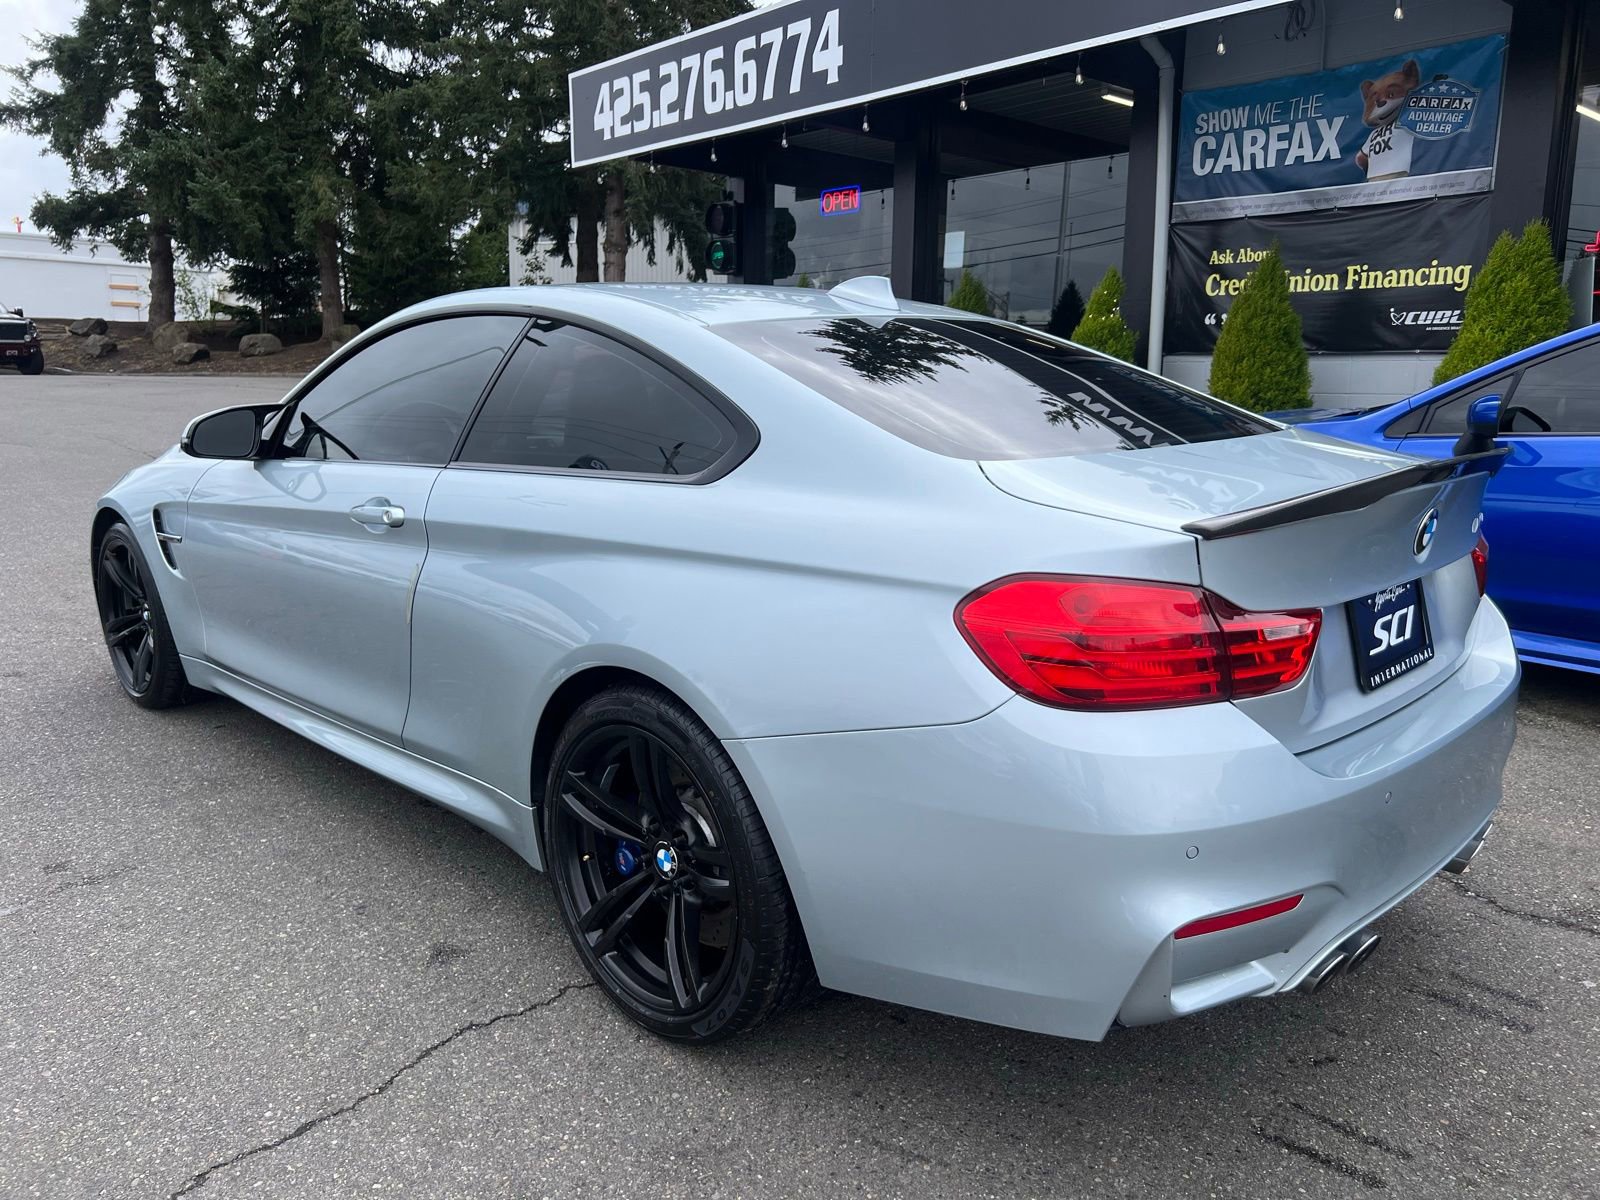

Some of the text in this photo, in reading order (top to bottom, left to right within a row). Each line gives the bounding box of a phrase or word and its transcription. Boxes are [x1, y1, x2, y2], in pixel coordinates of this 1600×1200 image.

[594, 9, 843, 140] 425.276.6774
[1195, 94, 1324, 134] SHOW ME THE
[1407, 97, 1473, 110] CARFAX
[1408, 112, 1464, 123] ADVANTAGE
[1416, 123, 1452, 133] DEALER
[1193, 116, 1345, 176] CARFAX
[1369, 137, 1393, 158] FOX
[823, 190, 859, 213] OPEN
[1209, 249, 1235, 265] Ask
[1345, 260, 1473, 292] Financing
[1369, 604, 1414, 655] SCI
[1370, 647, 1433, 687] INTERNATIONAL
